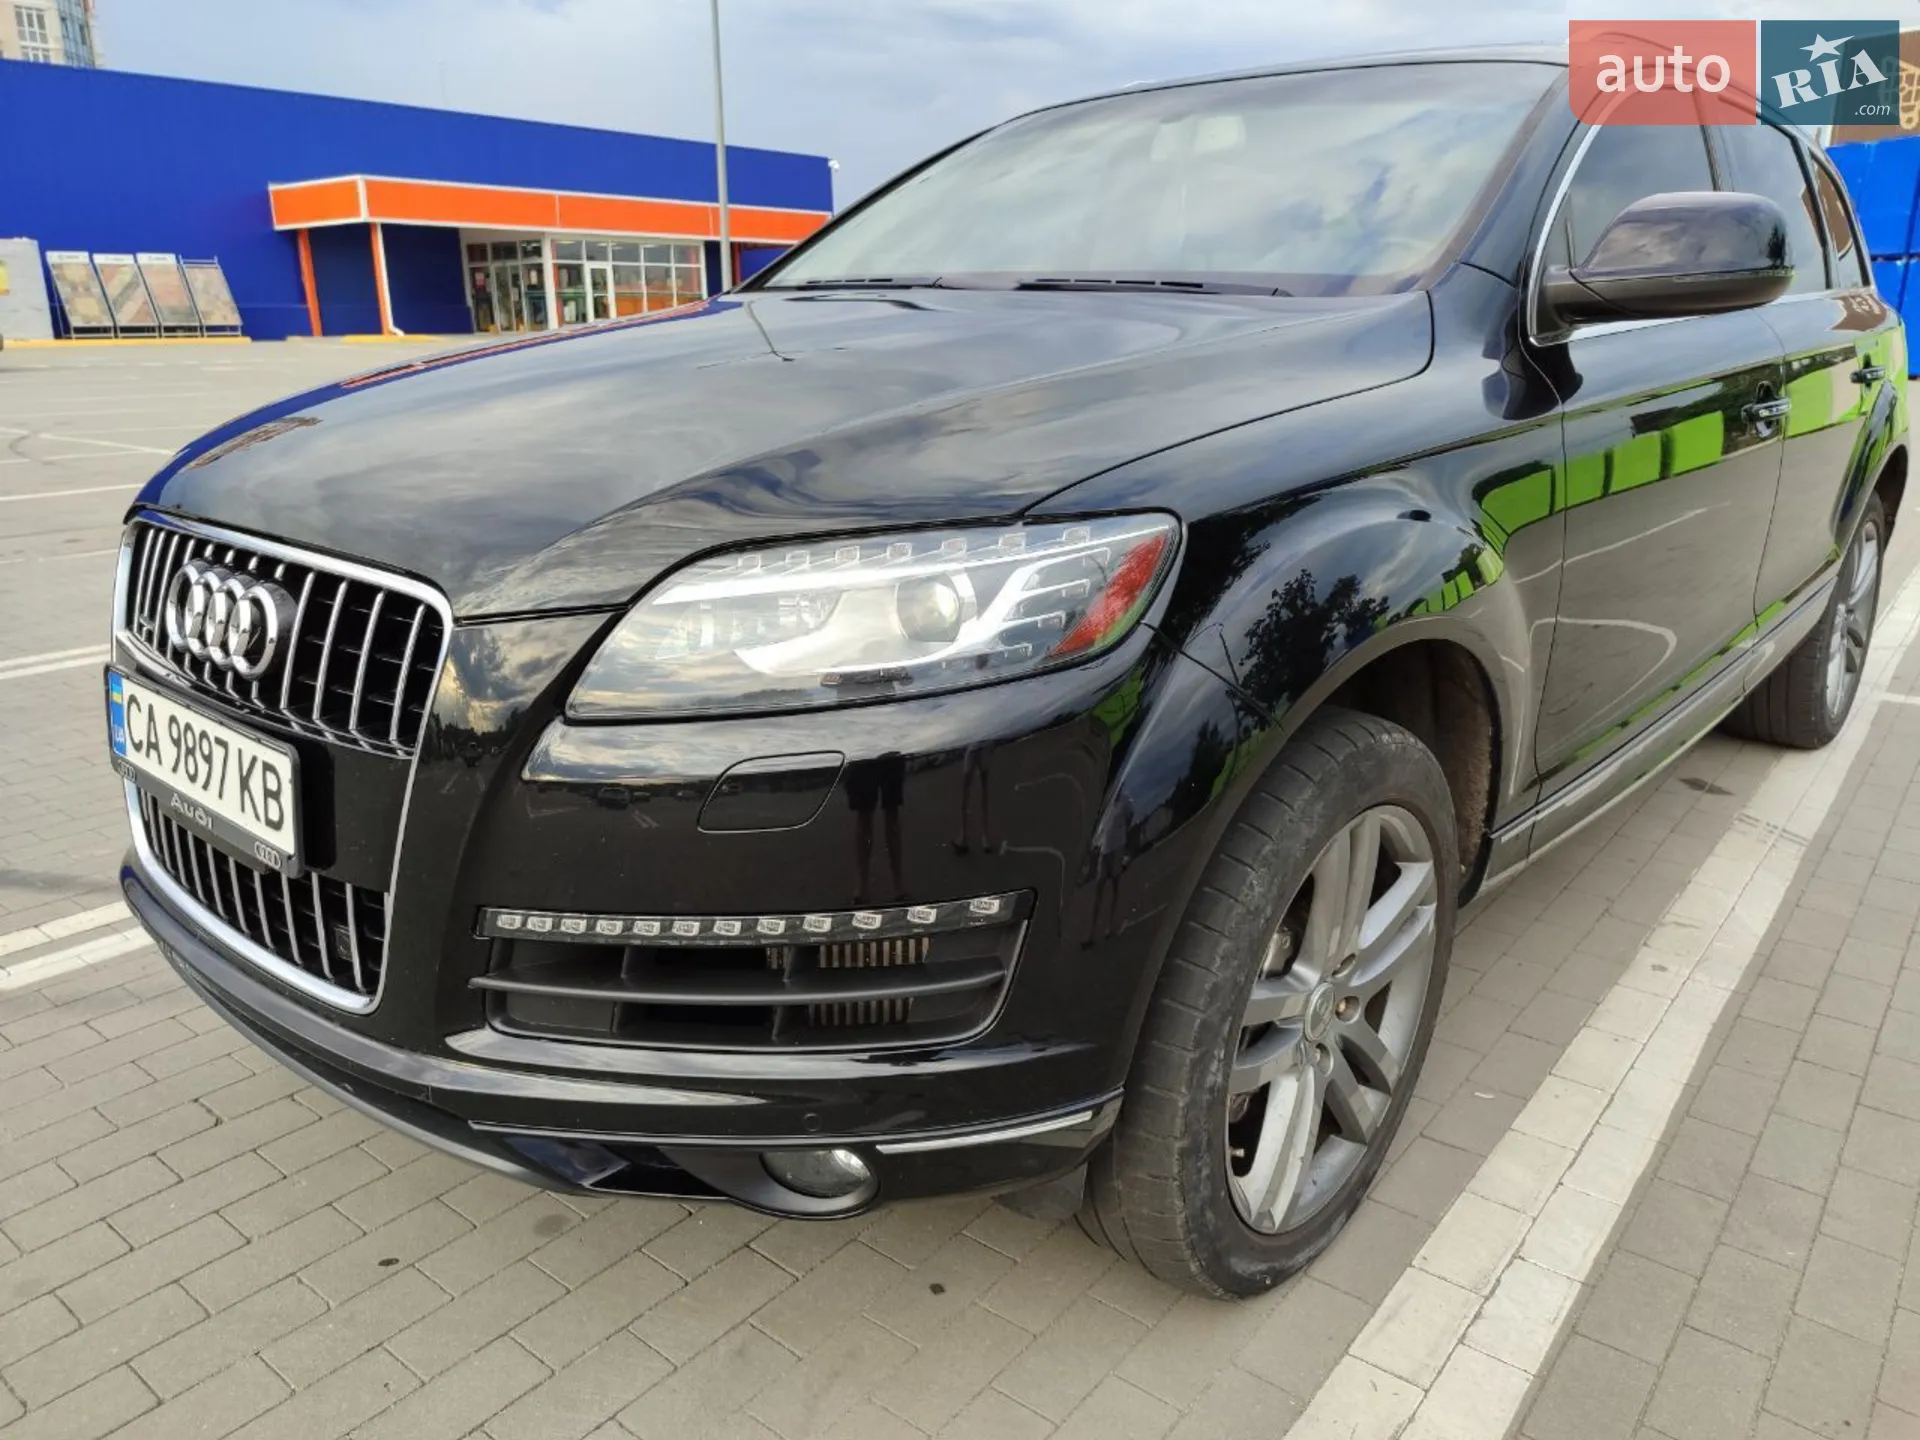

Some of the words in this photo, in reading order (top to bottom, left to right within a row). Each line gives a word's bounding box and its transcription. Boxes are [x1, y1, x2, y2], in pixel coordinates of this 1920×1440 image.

[126, 694, 163, 765] CA
[168, 714, 229, 800] 9897
[237, 748, 285, 832] KB
